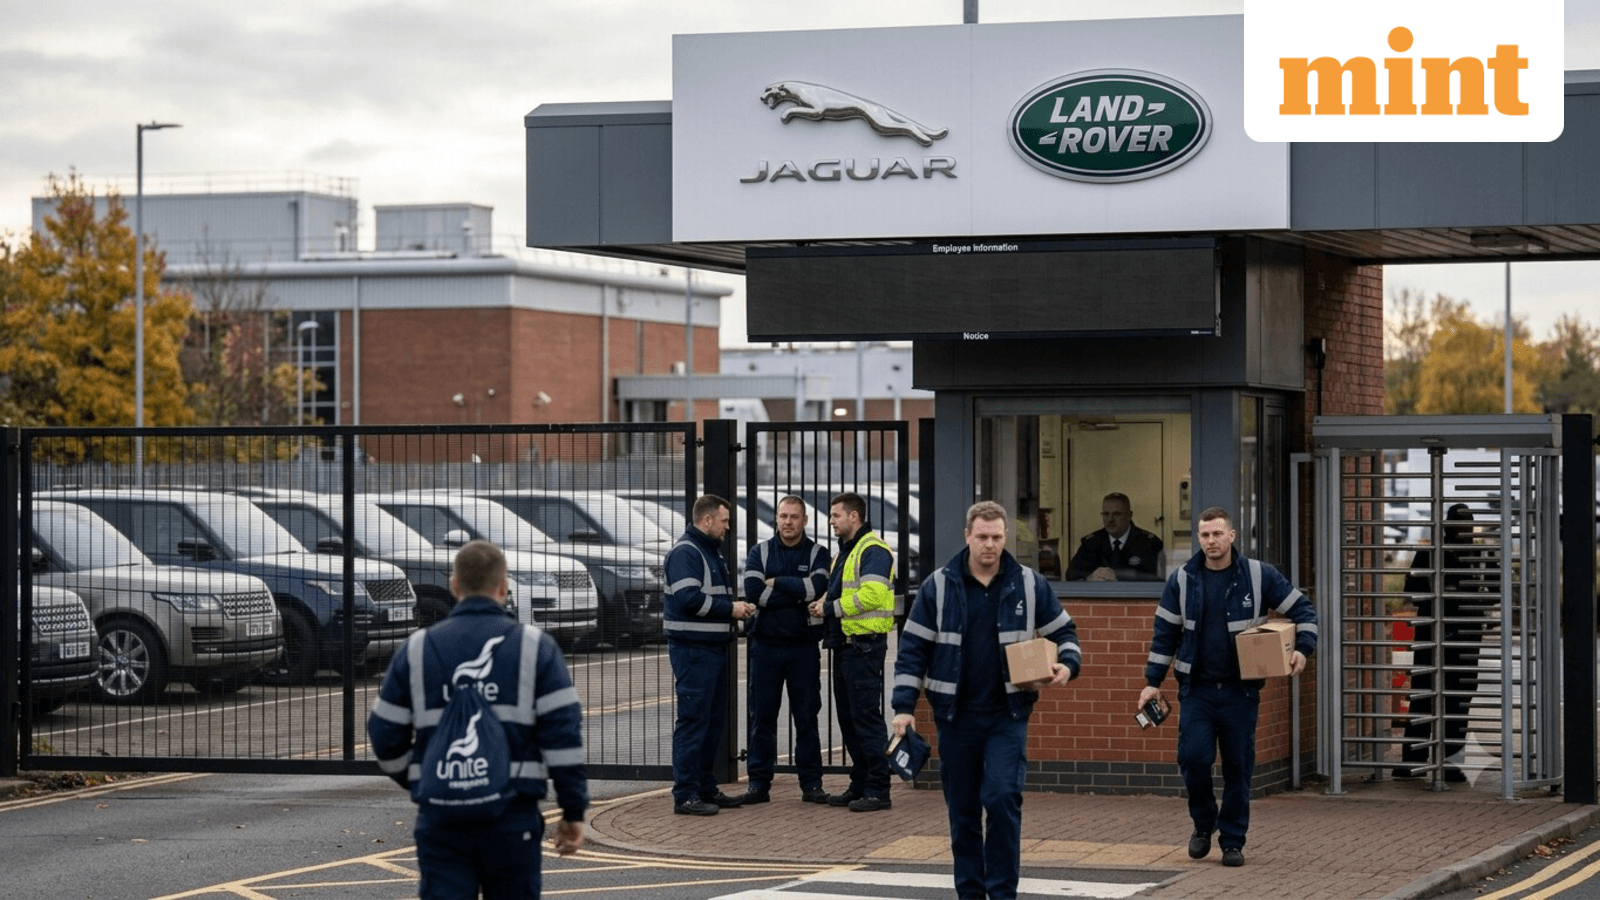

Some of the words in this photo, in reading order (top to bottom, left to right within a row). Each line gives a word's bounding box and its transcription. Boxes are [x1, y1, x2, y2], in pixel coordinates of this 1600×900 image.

[1049, 95, 1144, 123] LAND
[1057, 124, 1173, 154] ROVER
[740, 155, 957, 184] JAGUAR
[932, 244, 971, 254] Employee
[973, 243, 1018, 251] Information
[963, 332, 989, 340] Notice
[436, 757, 489, 779] unite
